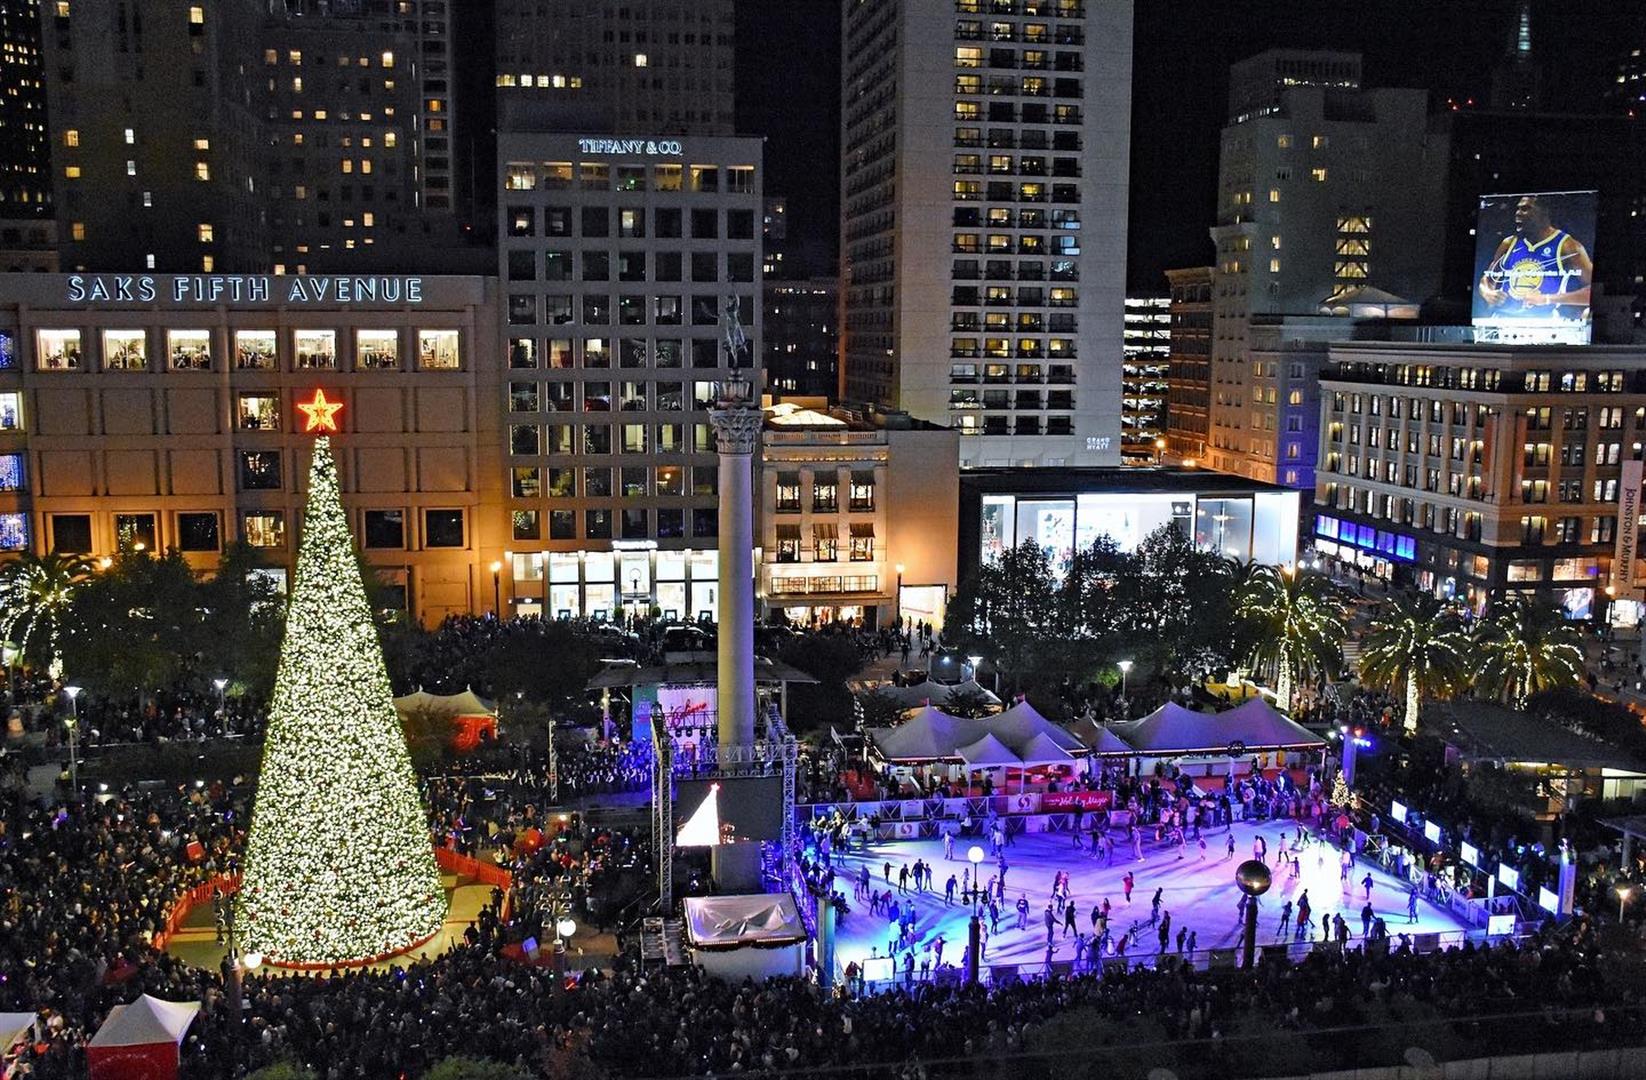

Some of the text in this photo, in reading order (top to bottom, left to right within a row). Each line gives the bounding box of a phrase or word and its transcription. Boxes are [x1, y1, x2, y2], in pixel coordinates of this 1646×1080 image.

[579, 138, 644, 154] TIFFANY
[646, 141, 658, 154] &
[68, 276, 422, 302] SAKS FIFTH AVENUE
[1620, 488, 1638, 583] JOHNSTON & MURPHY
